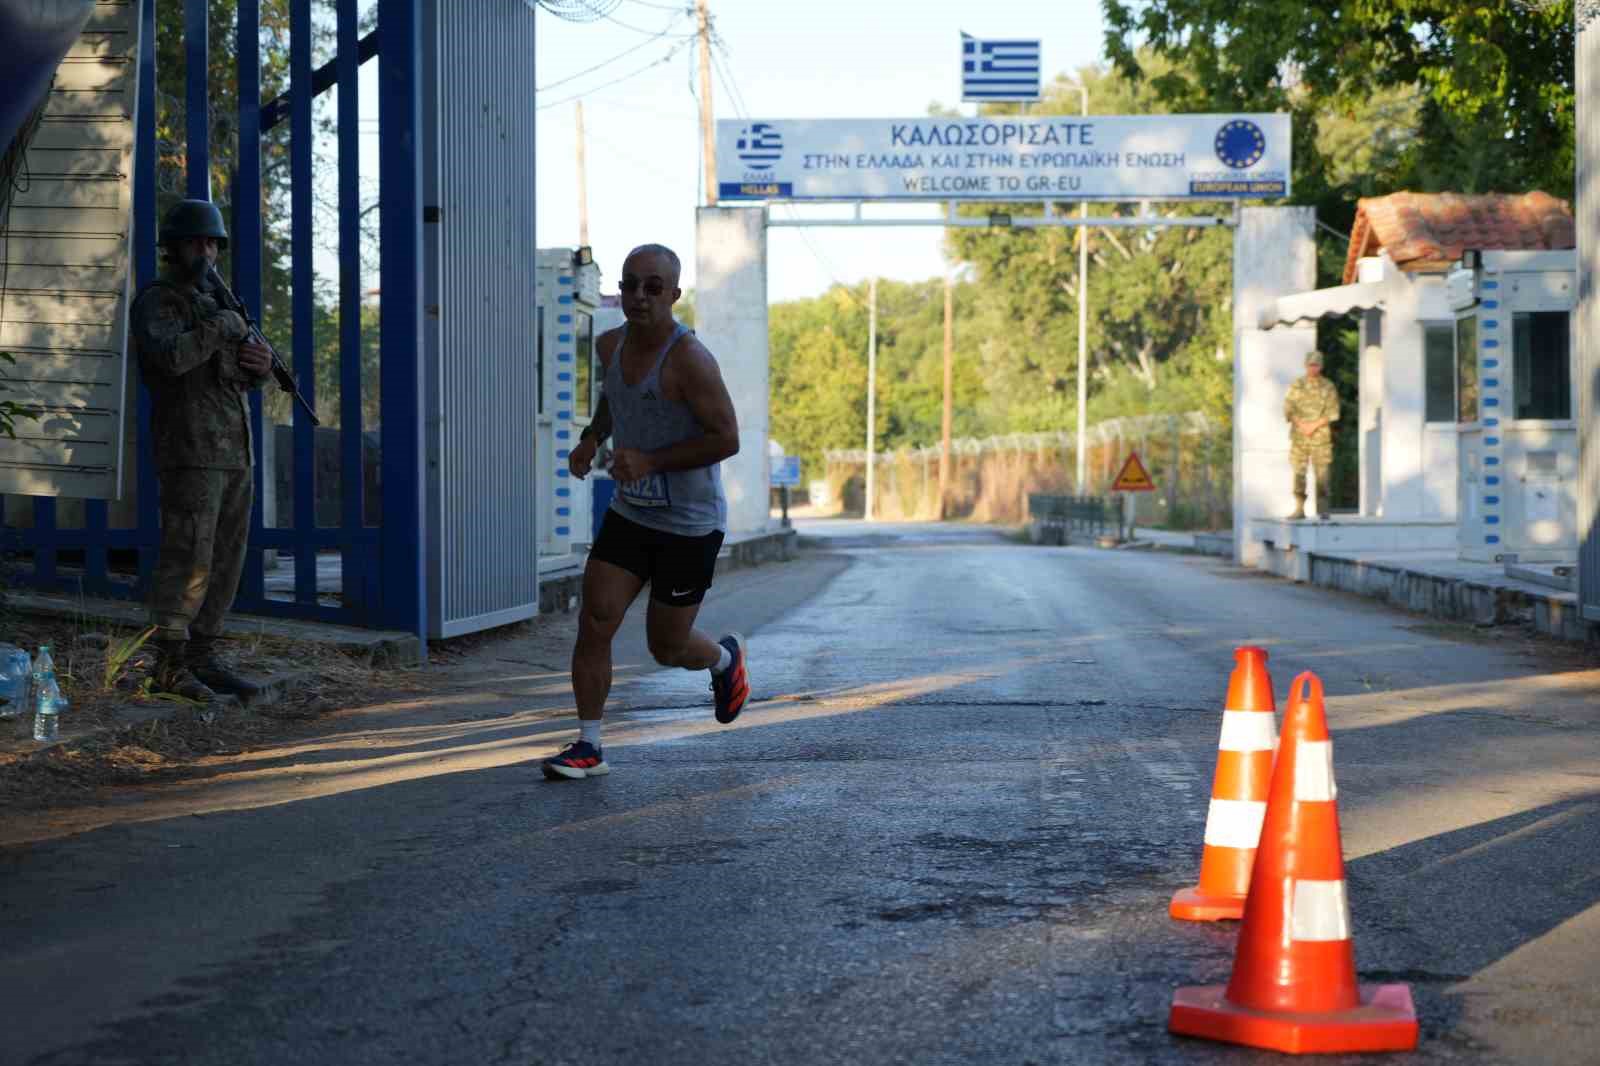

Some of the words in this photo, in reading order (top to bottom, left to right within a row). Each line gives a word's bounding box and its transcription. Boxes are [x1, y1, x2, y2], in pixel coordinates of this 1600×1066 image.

[891, 123, 1094, 146] ΚΑΛΩΣΟΡΙΣΑΤΕ
[803, 154, 849, 169] ΣΤΗΝ
[857, 154, 923, 169] ΕΛΛΑΔΑ
[931, 154, 959, 168] ΚΑΙ
[966, 153, 1013, 168] ΣΤΗΝ
[1020, 151, 1118, 168] ΕΥΡΩΠΑΪΚΗ
[1126, 152, 1185, 168] ΕΝΩΣΗ
[904, 176, 990, 191] WELCOME
[999, 176, 1020, 191] TO
[1026, 175, 1081, 191] GR-EU
